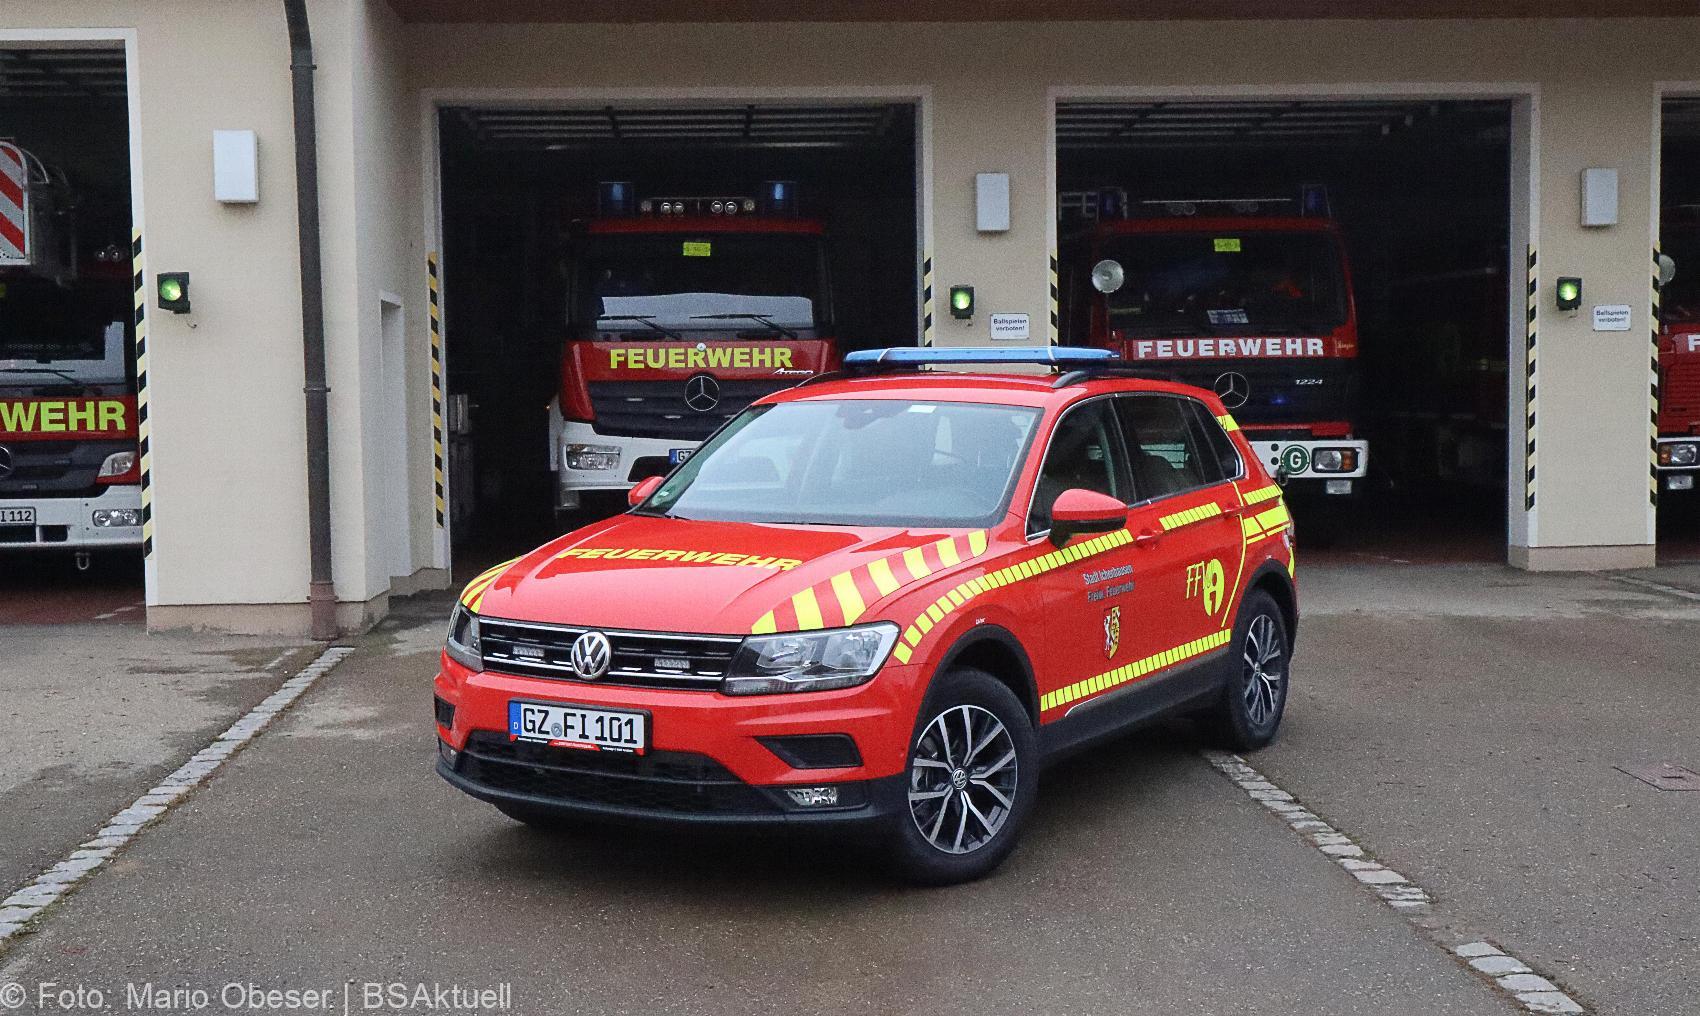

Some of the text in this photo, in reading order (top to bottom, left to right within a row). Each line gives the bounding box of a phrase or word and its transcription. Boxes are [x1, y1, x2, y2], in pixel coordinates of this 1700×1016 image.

[1137, 338, 1324, 359] FEUERWEHR
[1688, 334, 1700, 351] F
[610, 347, 793, 369] FEUERWEHR
[0, 400, 126, 432] WEHR
[1289, 451, 1302, 469] G
[10, 510, 32, 522] 112
[557, 548, 803, 571] FEUERWEHR
[523, 707, 550, 735] GZ
[595, 715, 637, 745] 101
